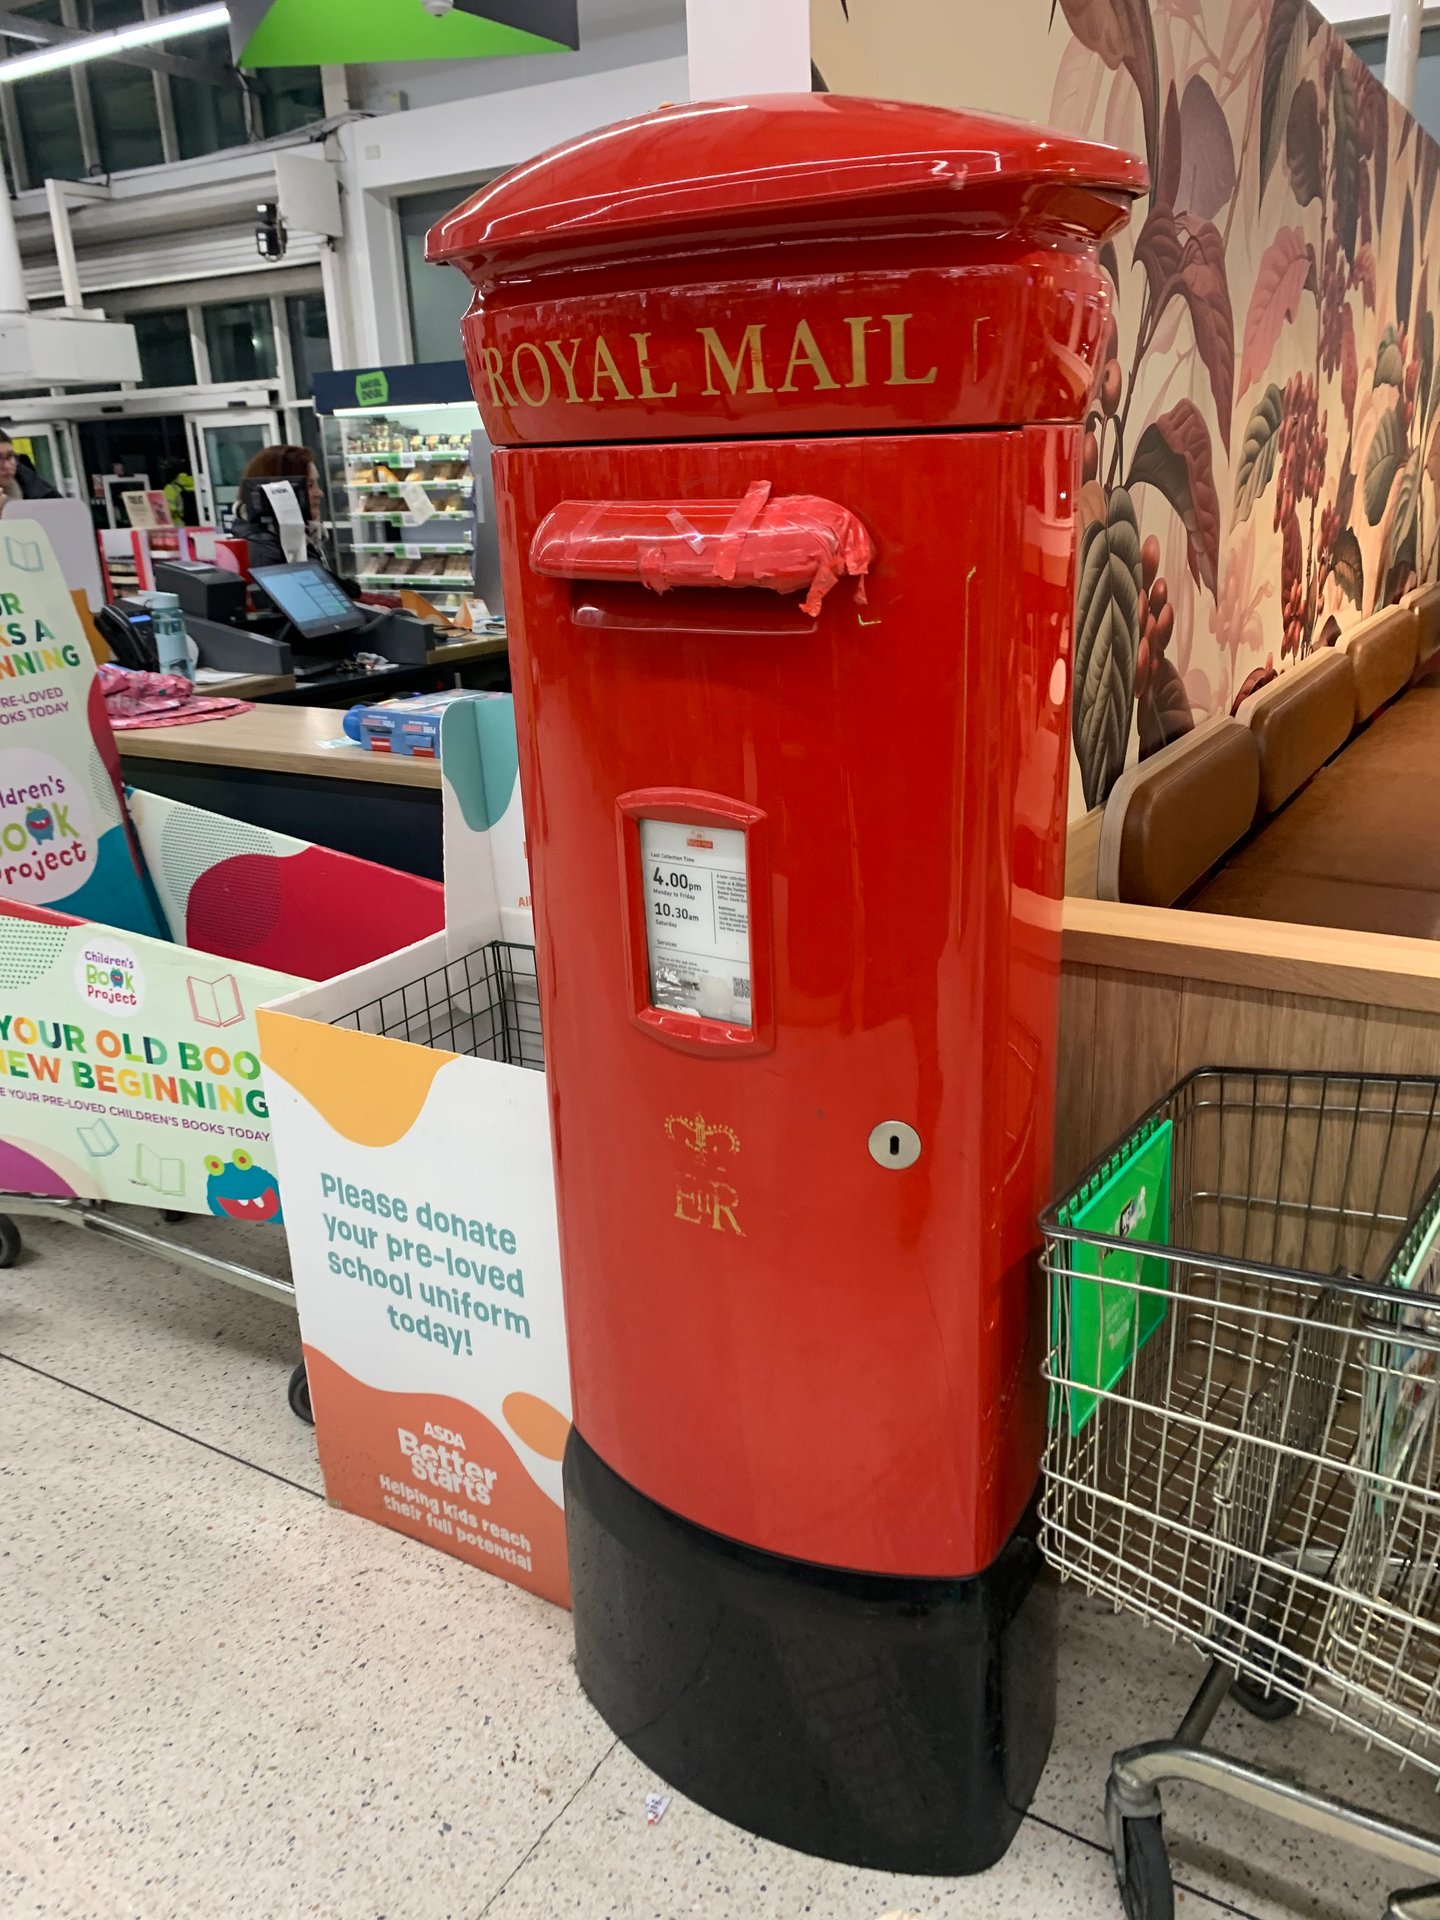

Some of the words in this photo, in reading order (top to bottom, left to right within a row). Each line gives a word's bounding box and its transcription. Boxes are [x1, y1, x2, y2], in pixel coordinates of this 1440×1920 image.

[481, 331, 677, 408] ROYAL
[696, 313, 938, 396] MAIL
[0, 592, 24, 616] R
[35, 619, 56, 642] A
[27, 701, 69, 719] TODAY
[0, 841, 86, 885] roject
[652, 866, 702, 892] 4.00pm
[661, 853, 683, 861] Collection
[653, 888, 673, 898] Monday
[680, 892, 696, 901] Friday
[654, 901, 700, 922] 10.30am
[655, 919, 678, 929] Saturday
[656, 938, 678, 948] Services
[84, 950, 135, 969] Children's
[87, 985, 137, 1006] Project
[0, 1015, 87, 1054] YOUR
[96, 1030, 168, 1066] OLD
[178, 1041, 261, 1081] BOO
[72, 1060, 270, 1119] BEGINNING
[9, 1088, 41, 1103] YOUR
[42, 1094, 107, 1115] PRE-LOVED
[109, 1106, 180, 1127] CHILDREN'S
[181, 1118, 225, 1136] BOOKS
[227, 1126, 270, 1142] TODAY
[320, 1172, 409, 1224] Please
[416, 1202, 517, 1255] donate
[322, 1213, 378, 1250] your
[386, 1233, 525, 1298] pre-loved
[327, 1251, 413, 1300] school
[419, 1282, 531, 1339] uniform
[387, 1304, 473, 1356] today!
[423, 1421, 467, 1451] ASDA
[398, 1427, 498, 1490] Better
[410, 1453, 491, 1506] Starts
[379, 1473, 440, 1516] Helping
[442, 1500, 479, 1530] kids
[481, 1518, 531, 1553] reach
[383, 1494, 422, 1521] their
[426, 1511, 453, 1536] full
[456, 1526, 533, 1572] potential
